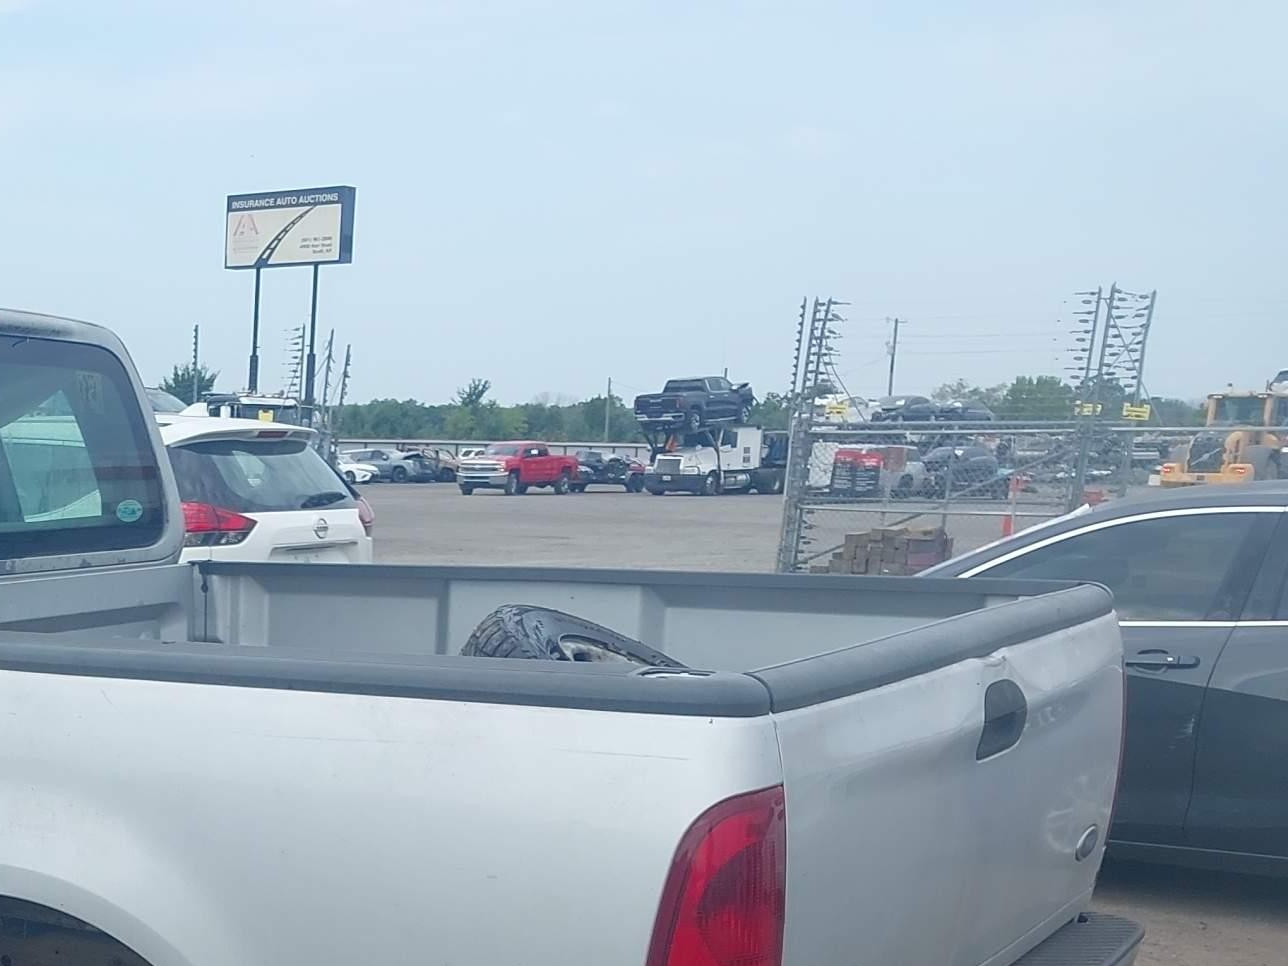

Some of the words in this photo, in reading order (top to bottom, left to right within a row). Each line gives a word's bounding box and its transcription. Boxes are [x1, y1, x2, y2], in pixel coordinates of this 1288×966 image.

[232, 198, 275, 209] INSURANCE
[276, 196, 297, 206] AUTO
[298, 193, 338, 204] AUCTIONS
